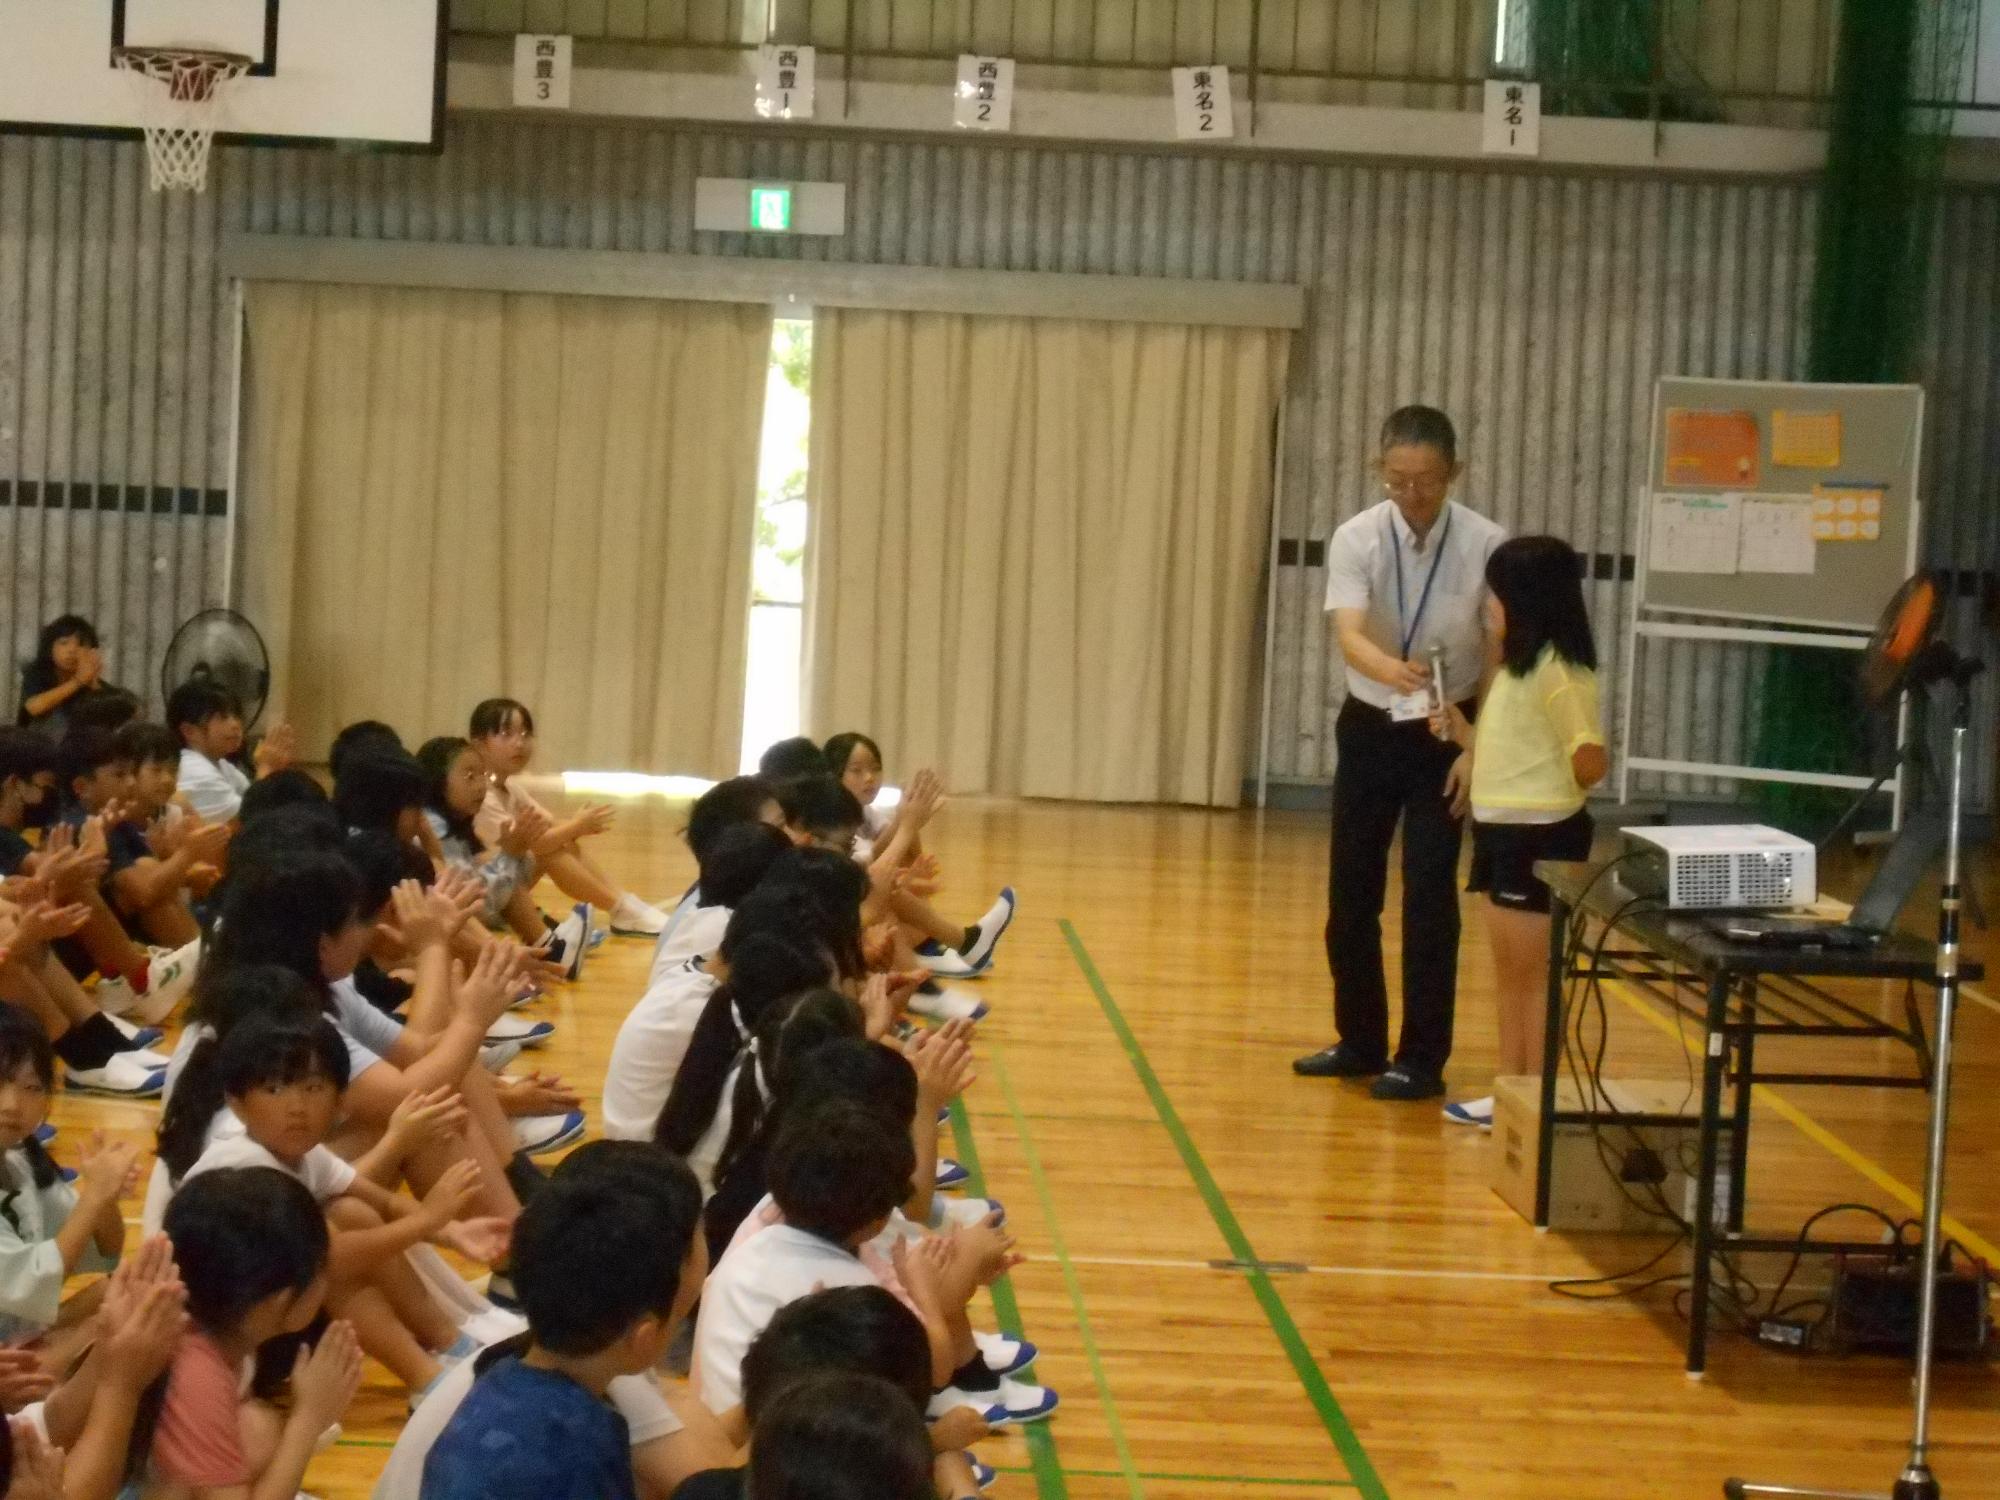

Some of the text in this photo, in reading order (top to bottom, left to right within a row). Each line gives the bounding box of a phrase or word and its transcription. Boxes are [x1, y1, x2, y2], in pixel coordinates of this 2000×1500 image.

[535, 40, 555, 100] 西豊3
[778, 51, 798, 109] 西豊1
[977, 62, 998, 123] 西豊2
[1193, 71, 1215, 132] 東名2
[1503, 86, 1523, 147] 東名1
